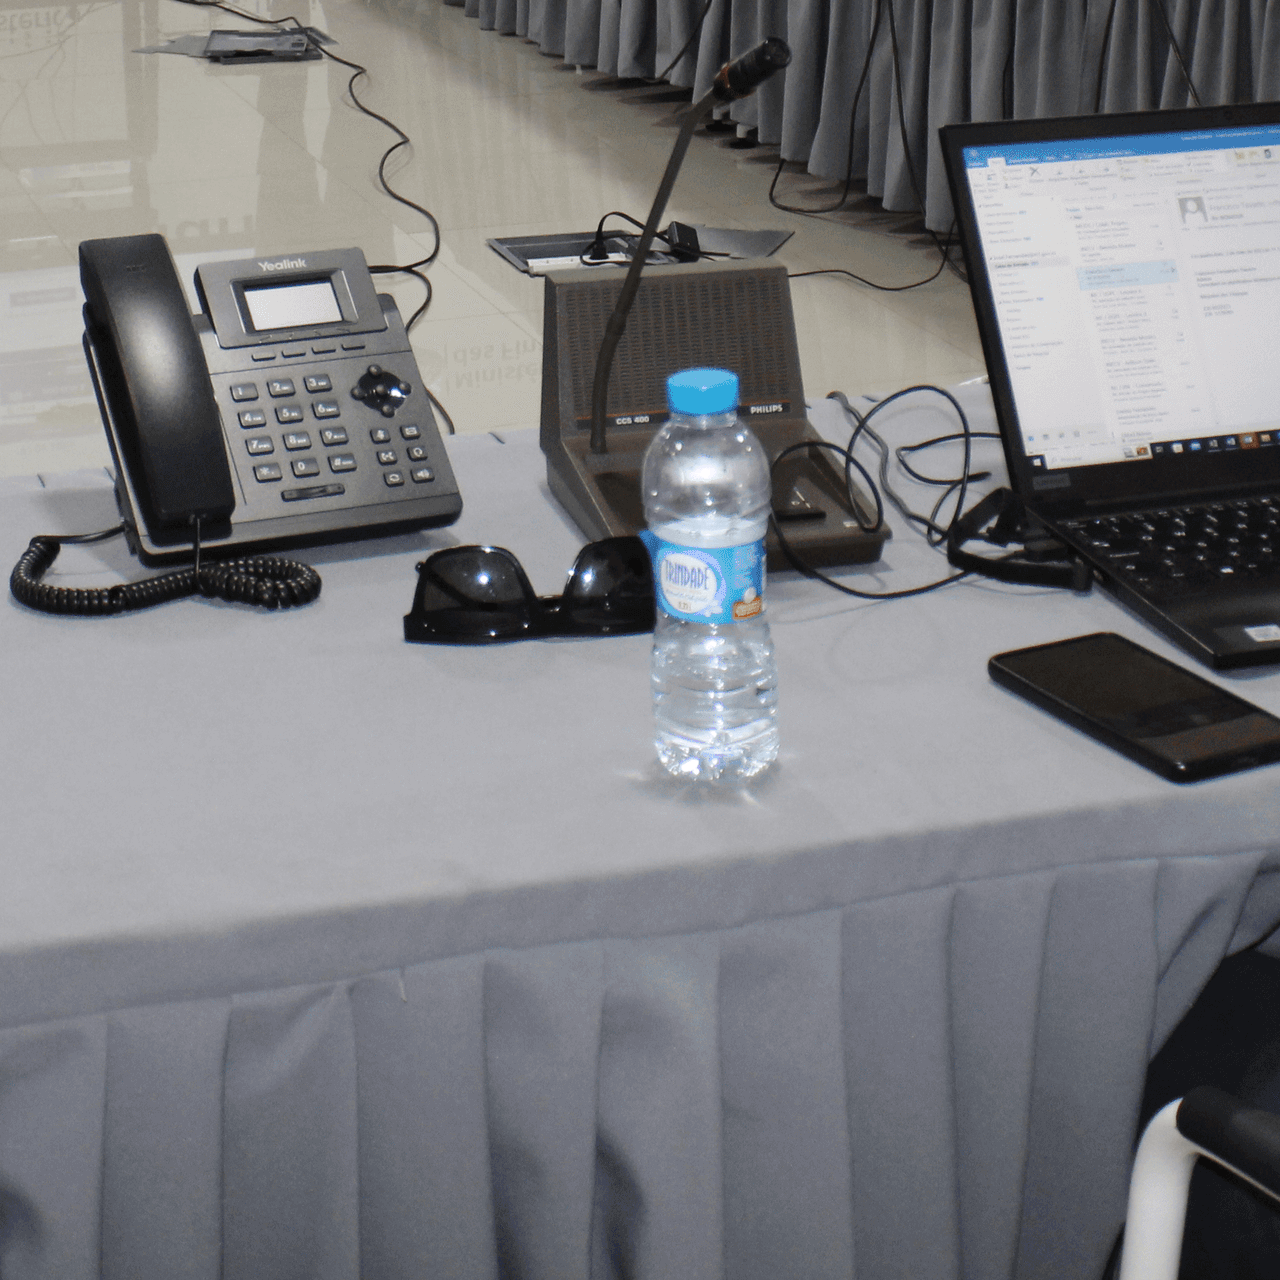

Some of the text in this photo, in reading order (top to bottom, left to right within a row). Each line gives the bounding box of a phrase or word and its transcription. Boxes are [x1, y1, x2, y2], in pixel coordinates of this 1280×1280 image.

[258, 258, 307, 272] Yealink
[750, 403, 783, 414] PHILIPS
[616, 416, 650, 425] CCS 400
[665, 558, 708, 591] TRINDADE
